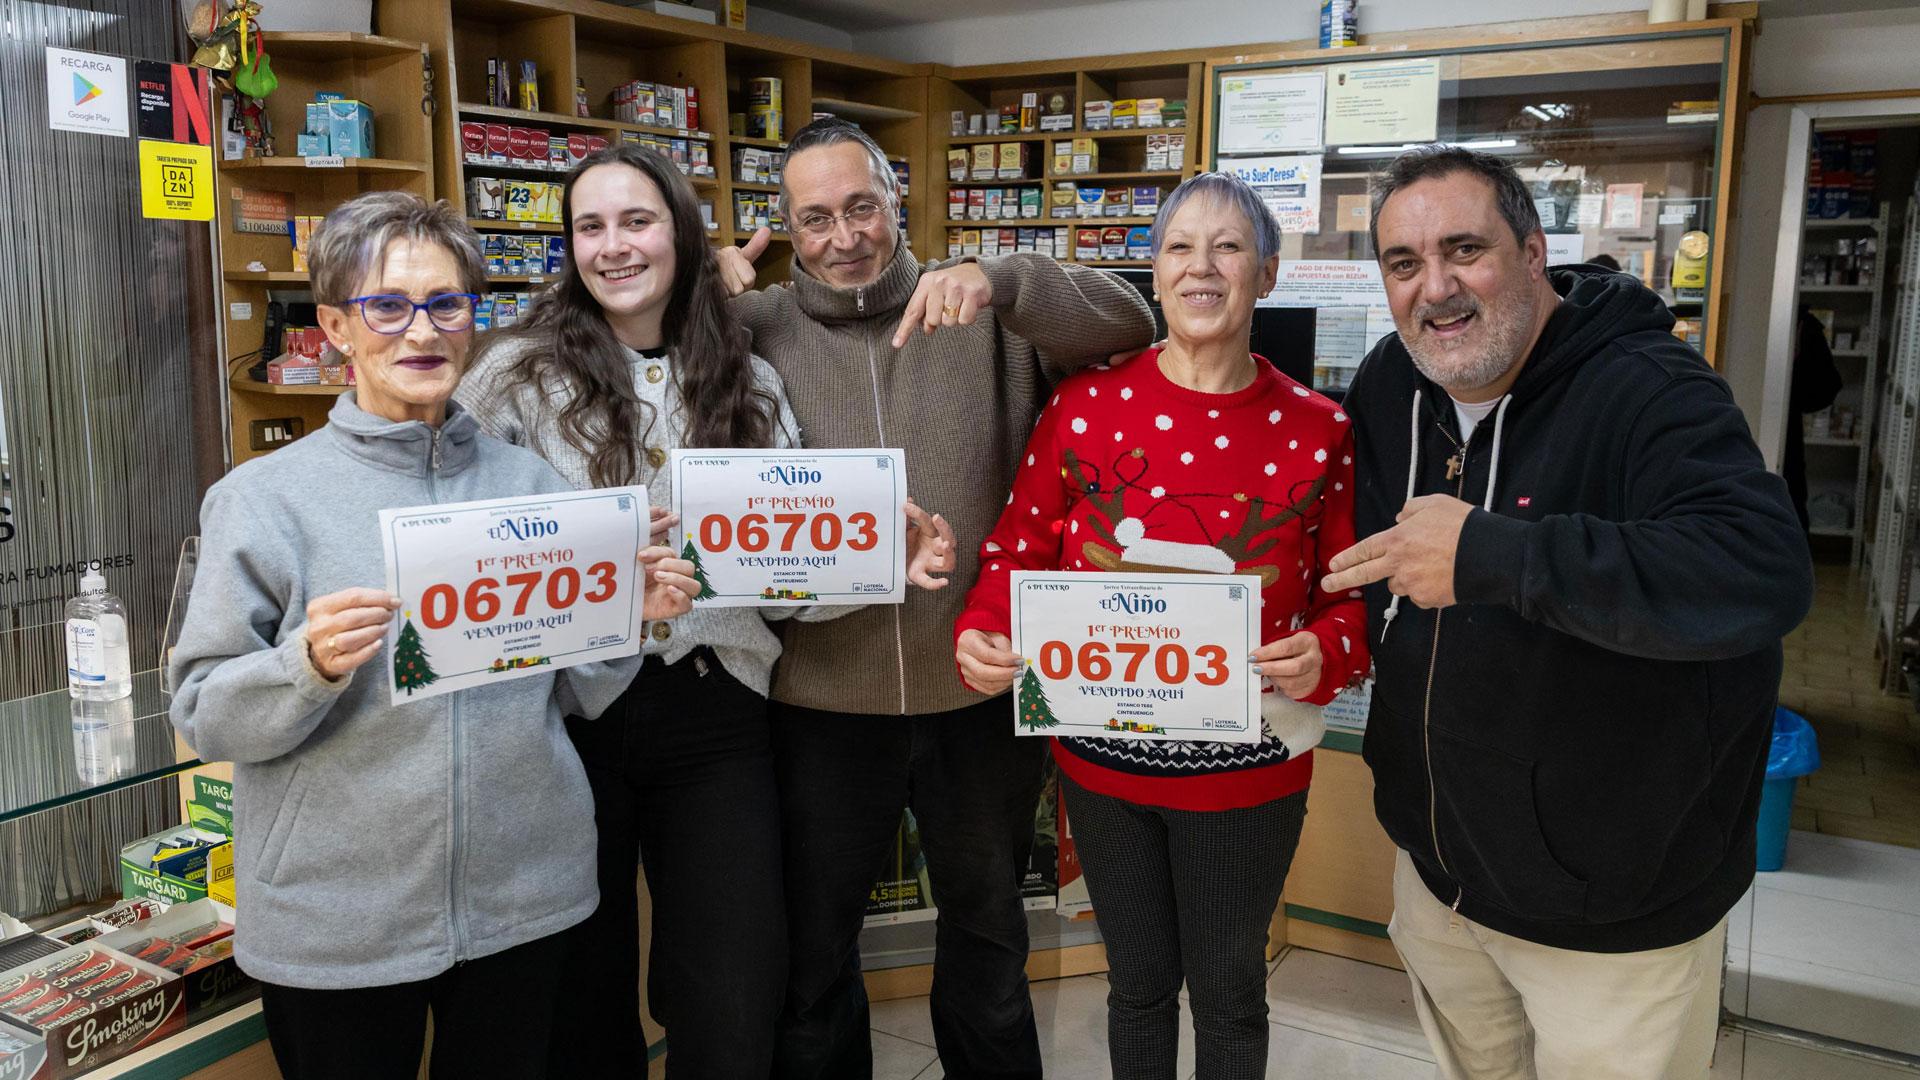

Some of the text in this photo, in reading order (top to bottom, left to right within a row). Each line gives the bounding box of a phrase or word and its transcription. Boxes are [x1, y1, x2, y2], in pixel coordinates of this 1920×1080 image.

[61, 57, 112, 73] RECARGA
[140, 80, 165, 91] NETFLIX
[141, 91, 164, 100] Recarga
[141, 98, 170, 107] disponible
[68, 110, 110, 123] Google Play
[465, 131, 483, 140] Fortuna
[489, 134, 507, 142] Fortuna
[510, 137, 529, 145] Fortuna
[510, 187, 530, 204] 23
[769, 465, 822, 486] Niño
[747, 493, 835, 510] 1er PREMIO
[500, 516, 559, 541] Niño
[700, 511, 879, 553] 06703
[25, 554, 134, 581] FUMADORES
[476, 548, 574, 573] 1er PREMIO
[736, 554, 837, 568] VENDIDO AQUÍ
[420, 561, 618, 630] 06703
[1111, 592, 1167, 615] Niño
[463, 612, 573, 641] VENDIDO AQUÍ
[1088, 624, 1180, 640] 1er PREMIO
[599, 637, 624, 646] NACIONAL
[1039, 640, 1230, 686] 06703
[1078, 686, 1184, 701] VENDIDO AQUÍ
[131, 871, 188, 900] TARGARD
[869, 889, 889, 903] 4,5
[879, 898, 918, 909] DOMINGOS
[32, 950, 94, 979] Smoking
[53, 959, 115, 988] Smoking
[75, 968, 138, 998] Smoking
[99, 977, 161, 1008] Smoking
[0, 984, 49, 1009] moking
[66, 989, 165, 1066] Smoking
[117, 1018, 145, 1044] BROWN
